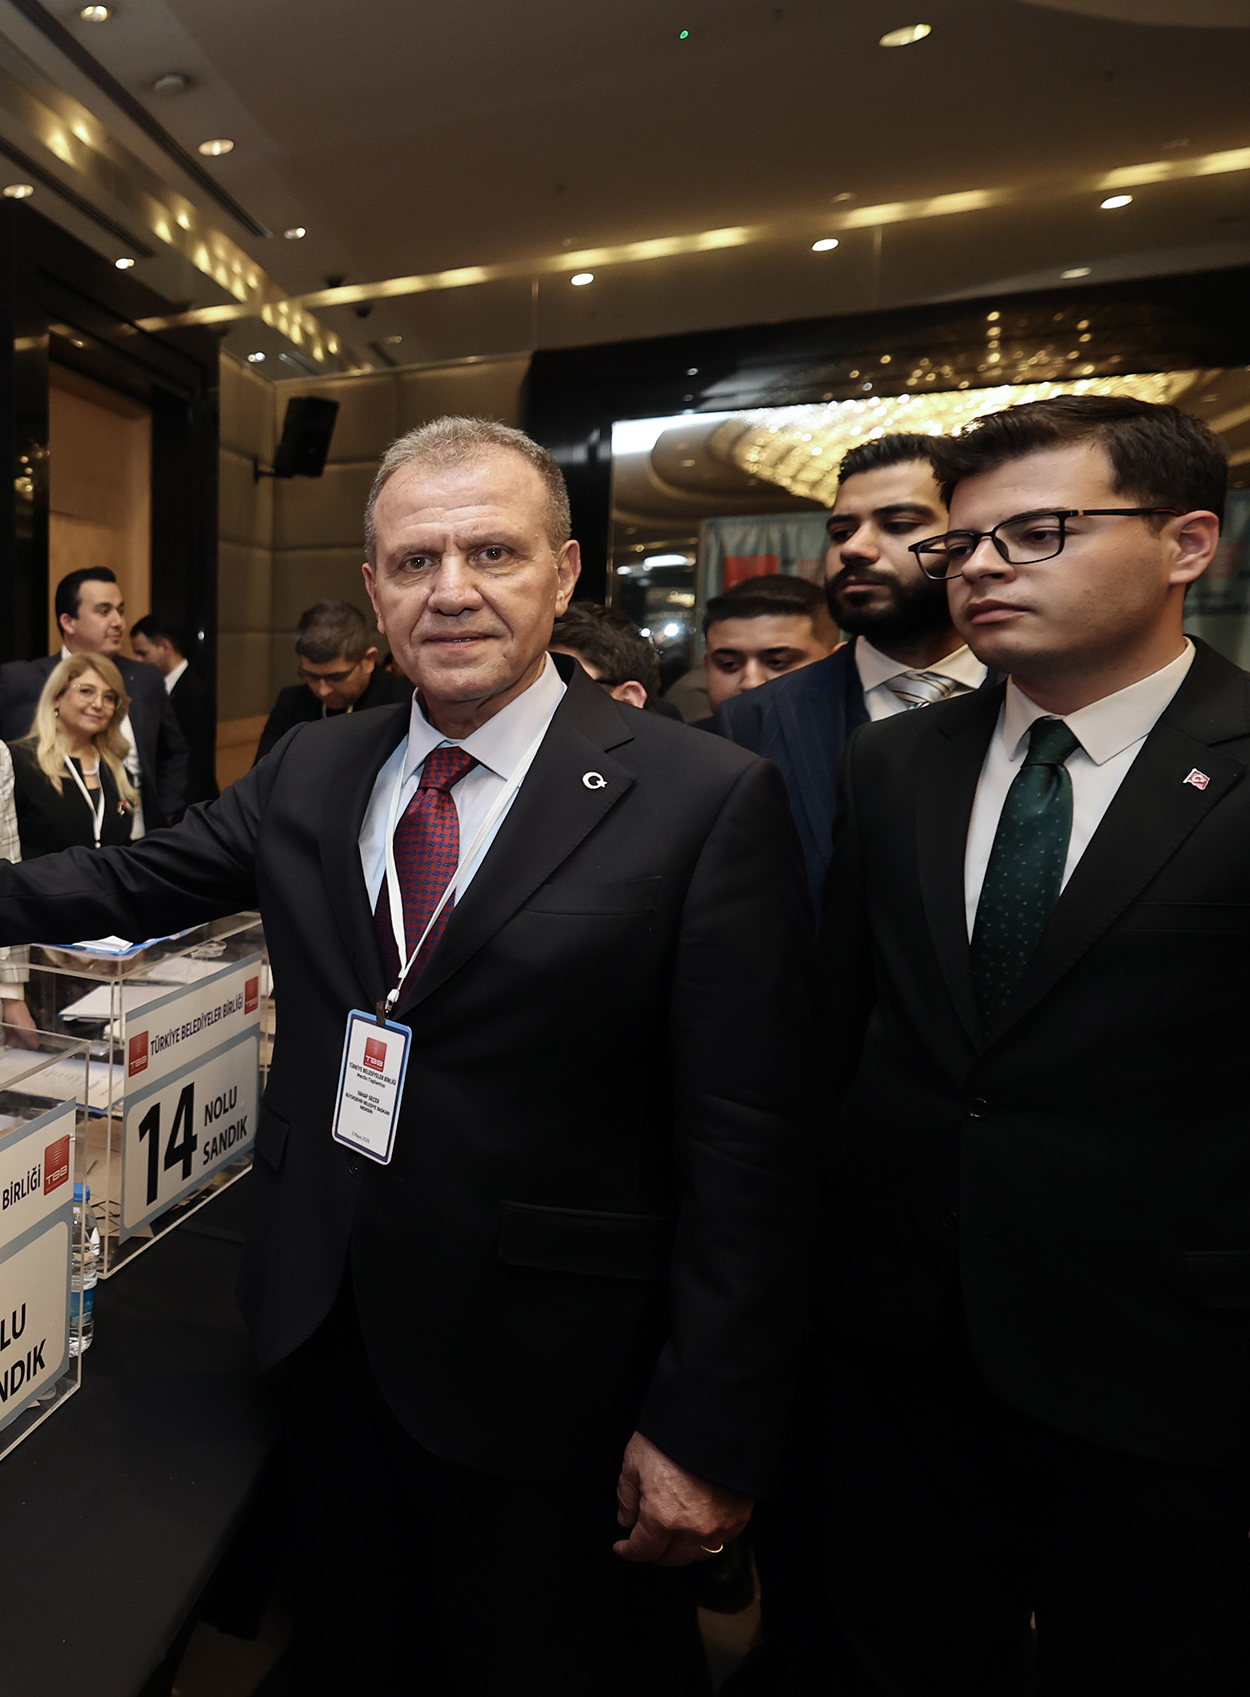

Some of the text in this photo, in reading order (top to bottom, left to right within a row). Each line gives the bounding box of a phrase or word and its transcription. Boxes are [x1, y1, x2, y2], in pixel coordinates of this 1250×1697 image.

[150, 992, 243, 1056] TÜRKİYE BELEDİYELER BİRLİĞİ
[130, 1055, 147, 1069] TBB
[204, 1085, 237, 1127] NOLU
[138, 1081, 198, 1206] 14
[203, 1115, 248, 1165] SANDIK
[2, 1163, 41, 1211] BİRLİĞİ
[46, 1164, 68, 1185] TBB
